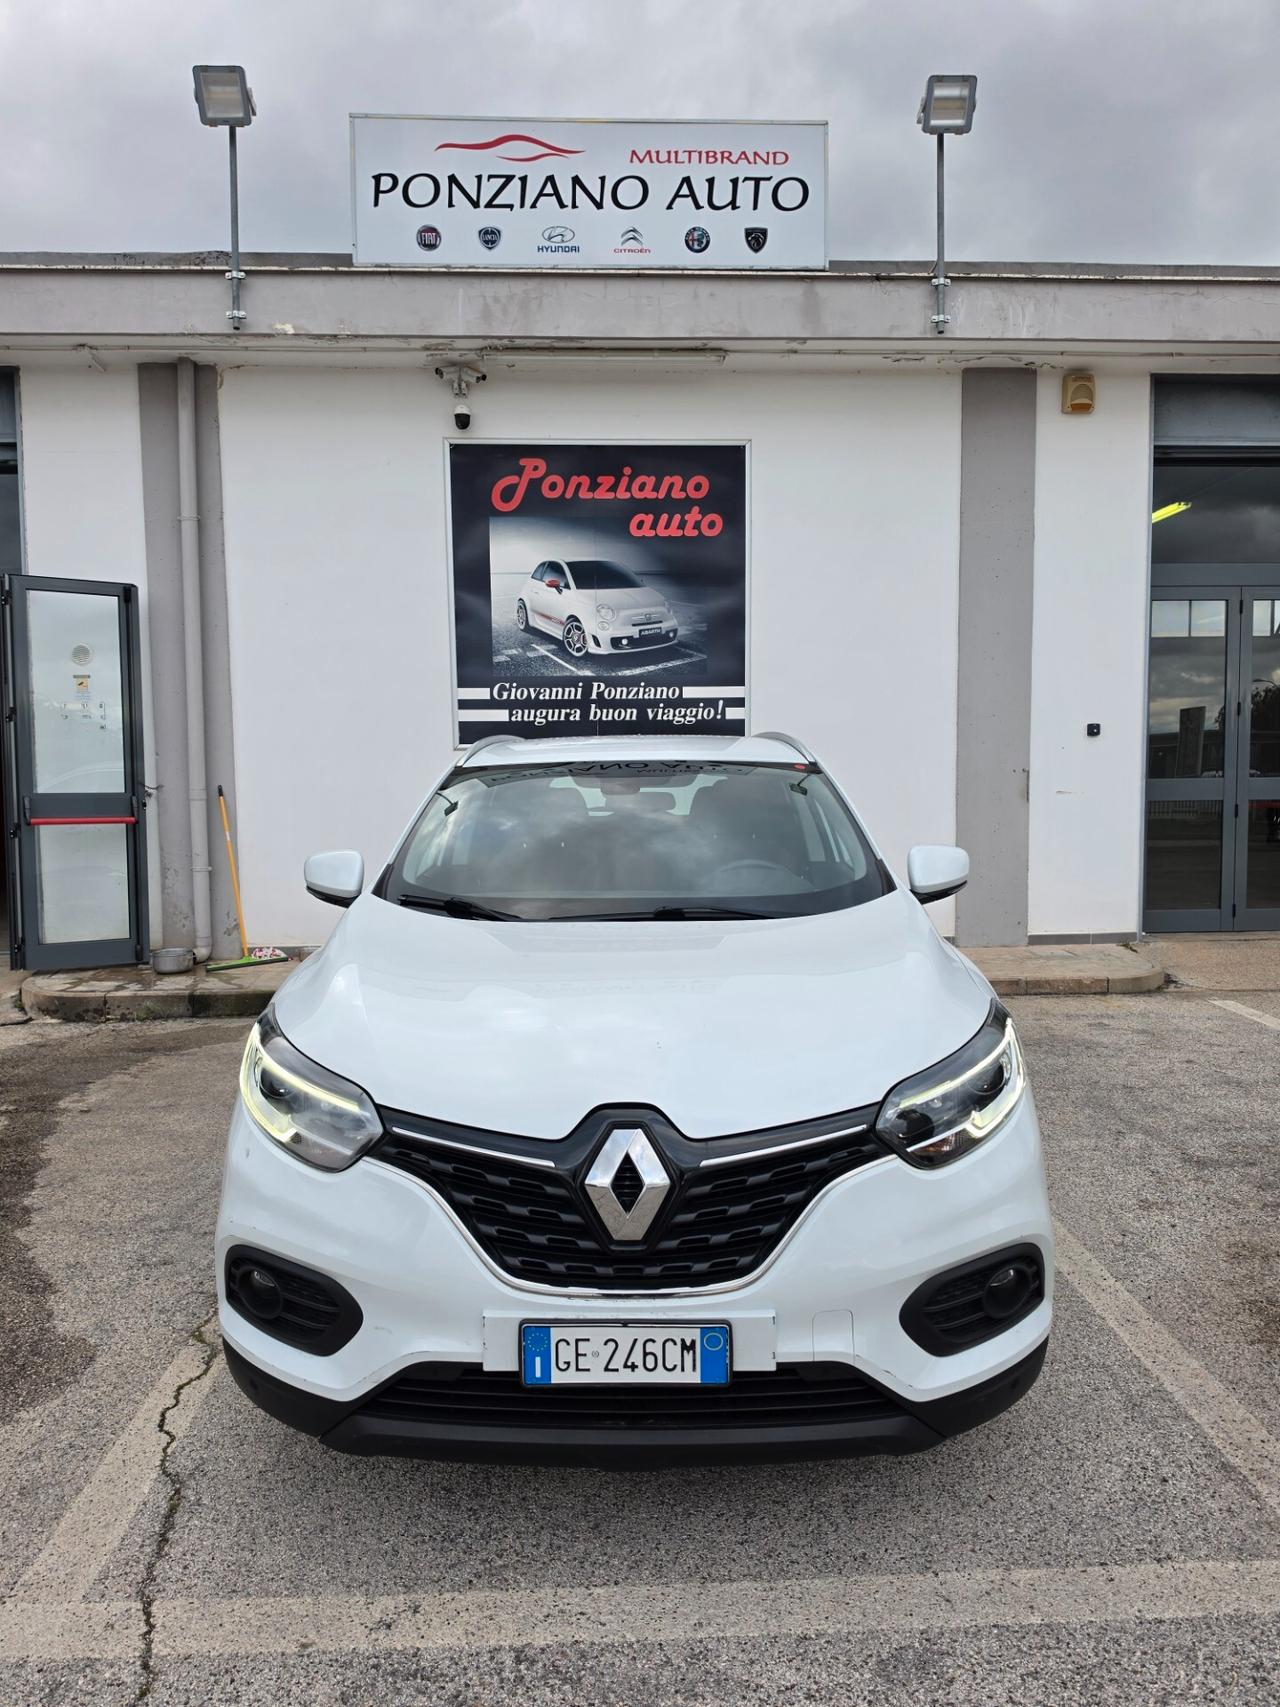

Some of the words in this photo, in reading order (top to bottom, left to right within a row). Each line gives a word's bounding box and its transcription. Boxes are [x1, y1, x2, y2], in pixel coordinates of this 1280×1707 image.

[631, 149, 788, 165] MULTIBRAND
[372, 173, 649, 212] PONZIANO
[666, 176, 810, 211] AUTO
[421, 232, 437, 245] FIAT
[537, 245, 580, 253] HYUNDAI
[491, 457, 710, 512] Ponziano
[629, 506, 723, 537] auto
[492, 682, 583, 700] Giovanni
[590, 682, 680, 700] Ponziano
[510, 709, 581, 726] augura
[589, 704, 637, 720] buon
[646, 700, 724, 725] viaggio!
